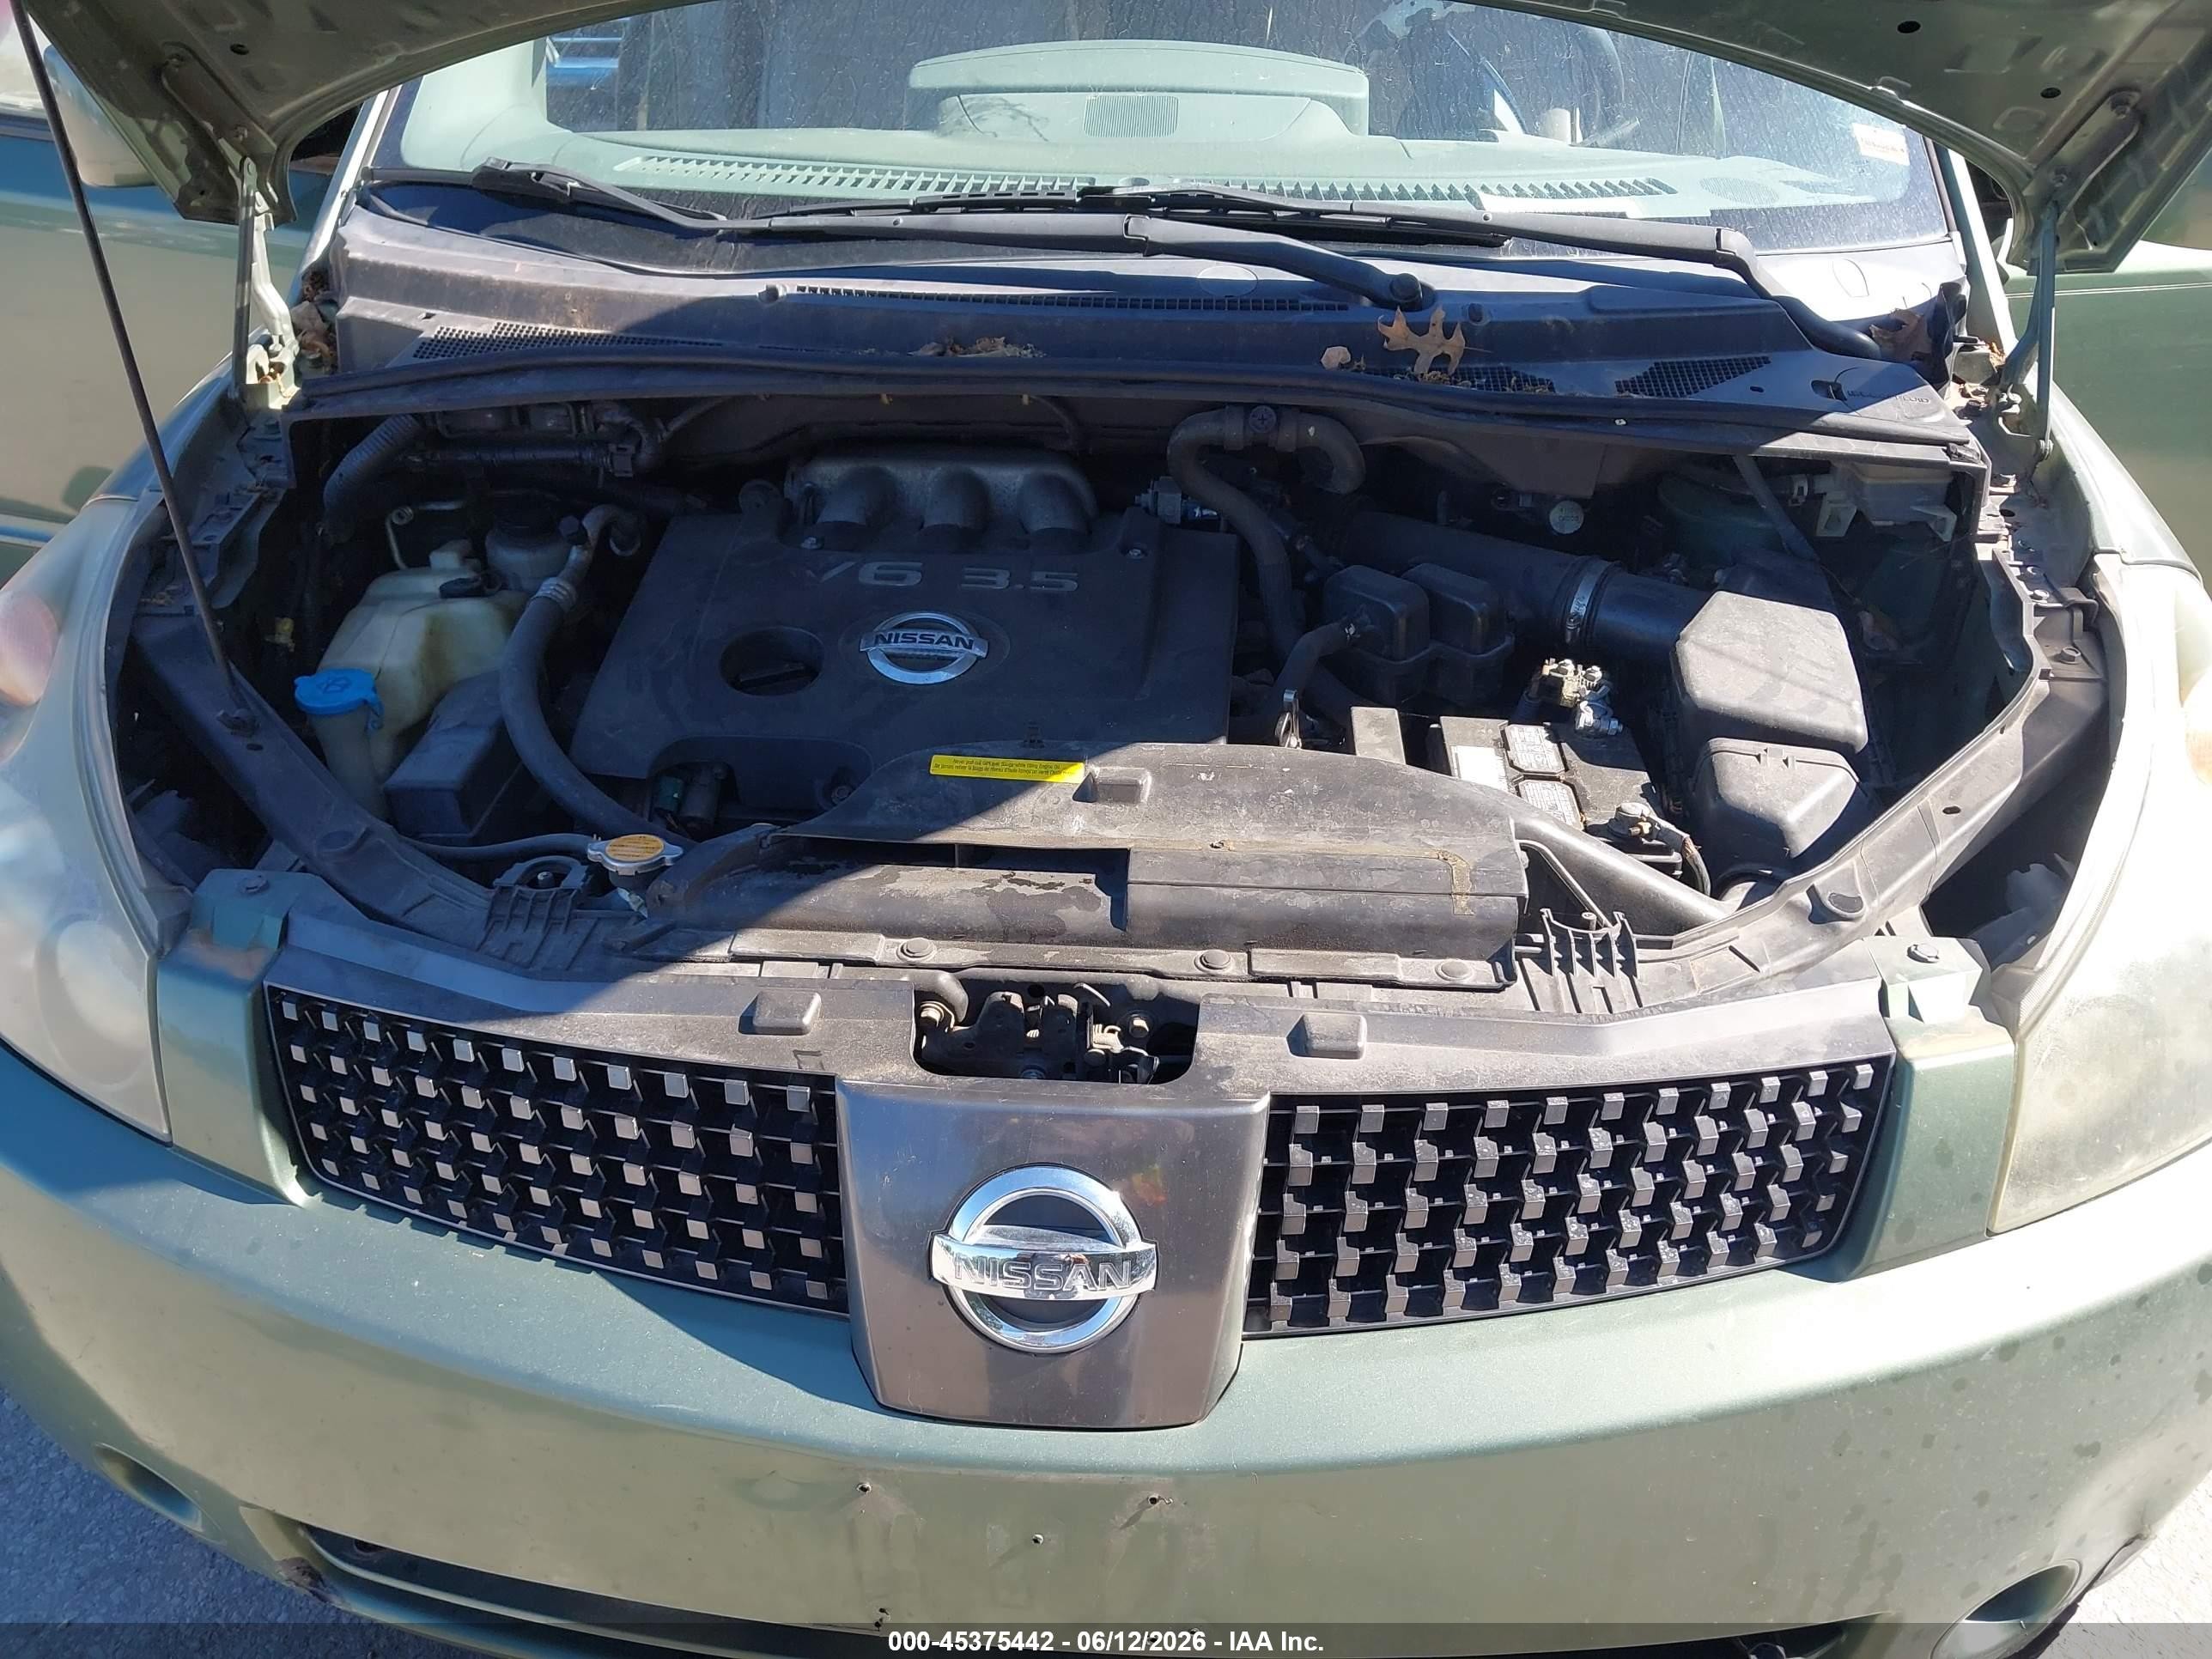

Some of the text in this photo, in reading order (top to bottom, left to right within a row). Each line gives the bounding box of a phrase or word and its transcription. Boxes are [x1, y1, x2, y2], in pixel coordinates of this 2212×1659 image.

[960, 567, 1079, 592] 3.5
[874, 632, 975, 650] NISSAN
[954, 1251, 1132, 1291] NISSAN
